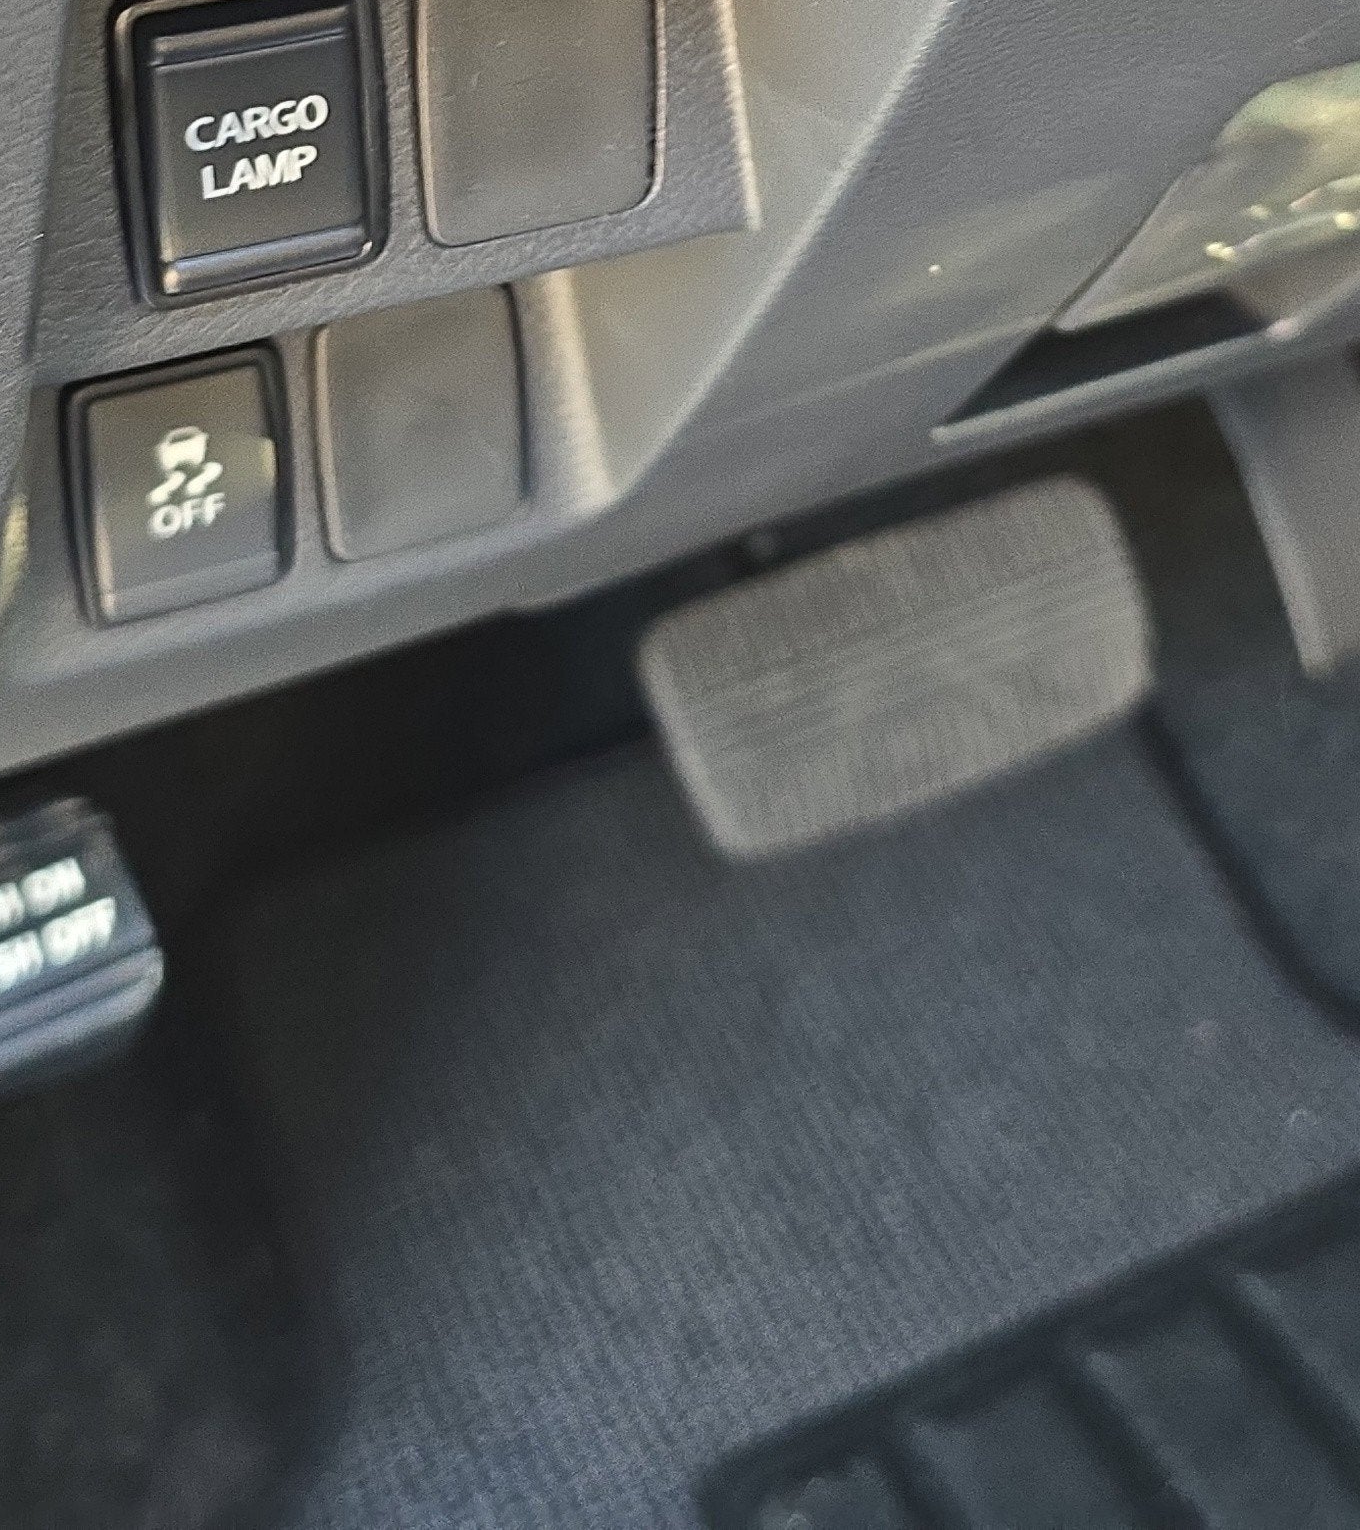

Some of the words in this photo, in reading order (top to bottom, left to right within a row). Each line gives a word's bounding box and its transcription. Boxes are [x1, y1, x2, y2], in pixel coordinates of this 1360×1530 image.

[185, 94, 328, 152] CARGO
[200, 145, 318, 199] LAMP
[149, 492, 226, 538] OFF
[40, 896, 116, 966] OFF
